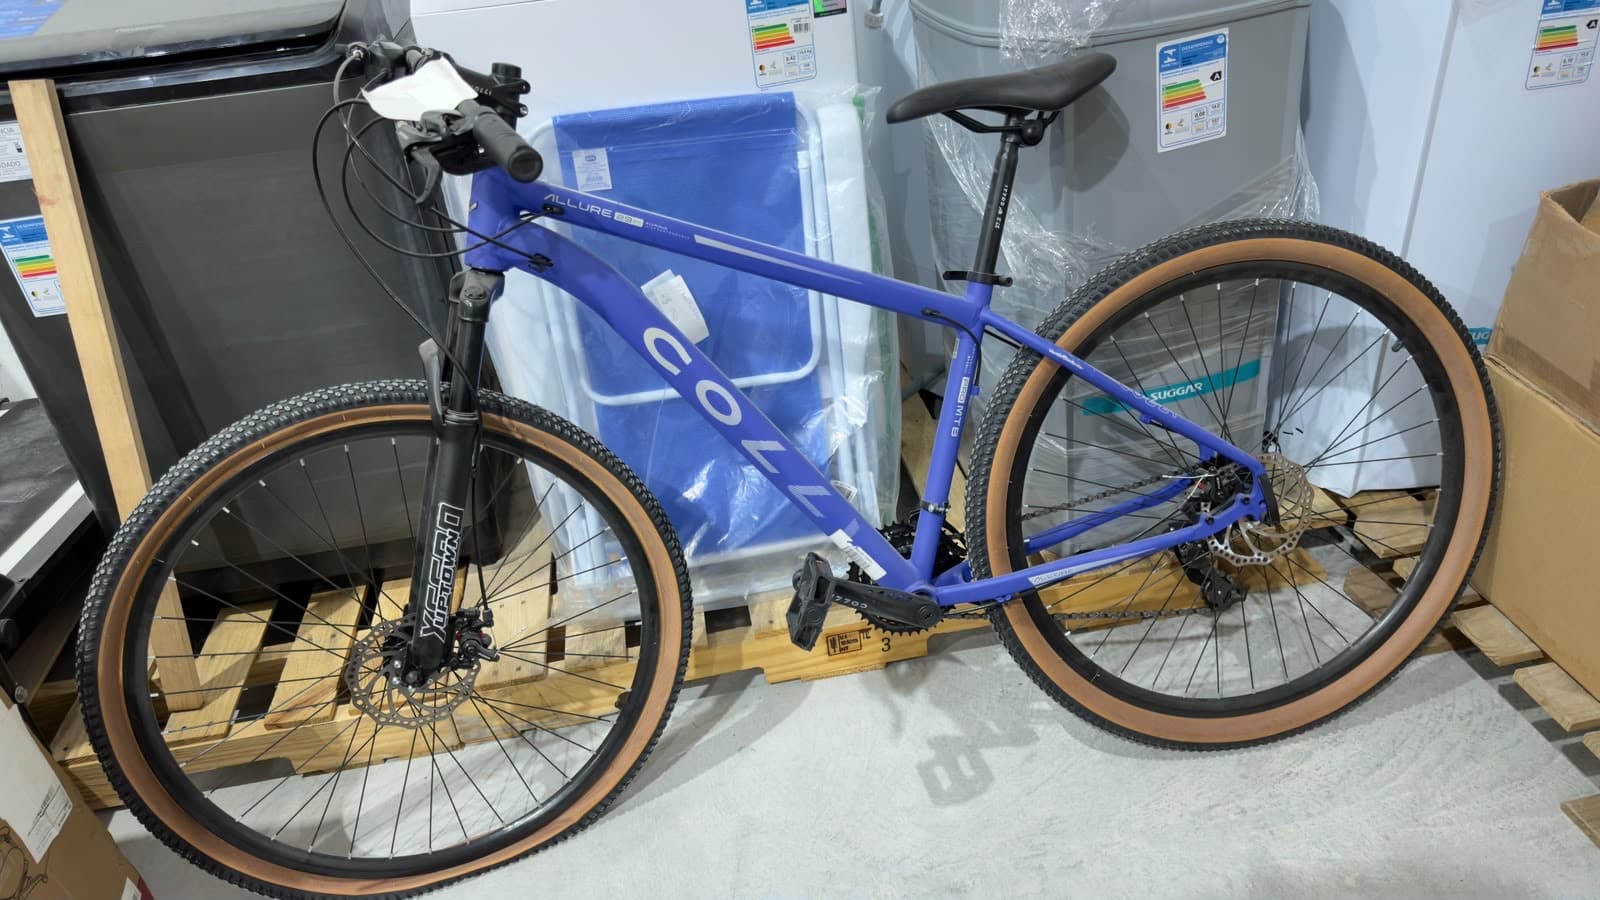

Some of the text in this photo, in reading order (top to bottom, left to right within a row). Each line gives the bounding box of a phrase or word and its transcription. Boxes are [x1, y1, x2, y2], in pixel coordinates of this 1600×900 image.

[544, 194, 613, 218] ALLURE
[1151, 382, 1203, 401] SUGGAR
[433, 528, 460, 629] UPTOWN
[881, 637, 891, 652] 3
